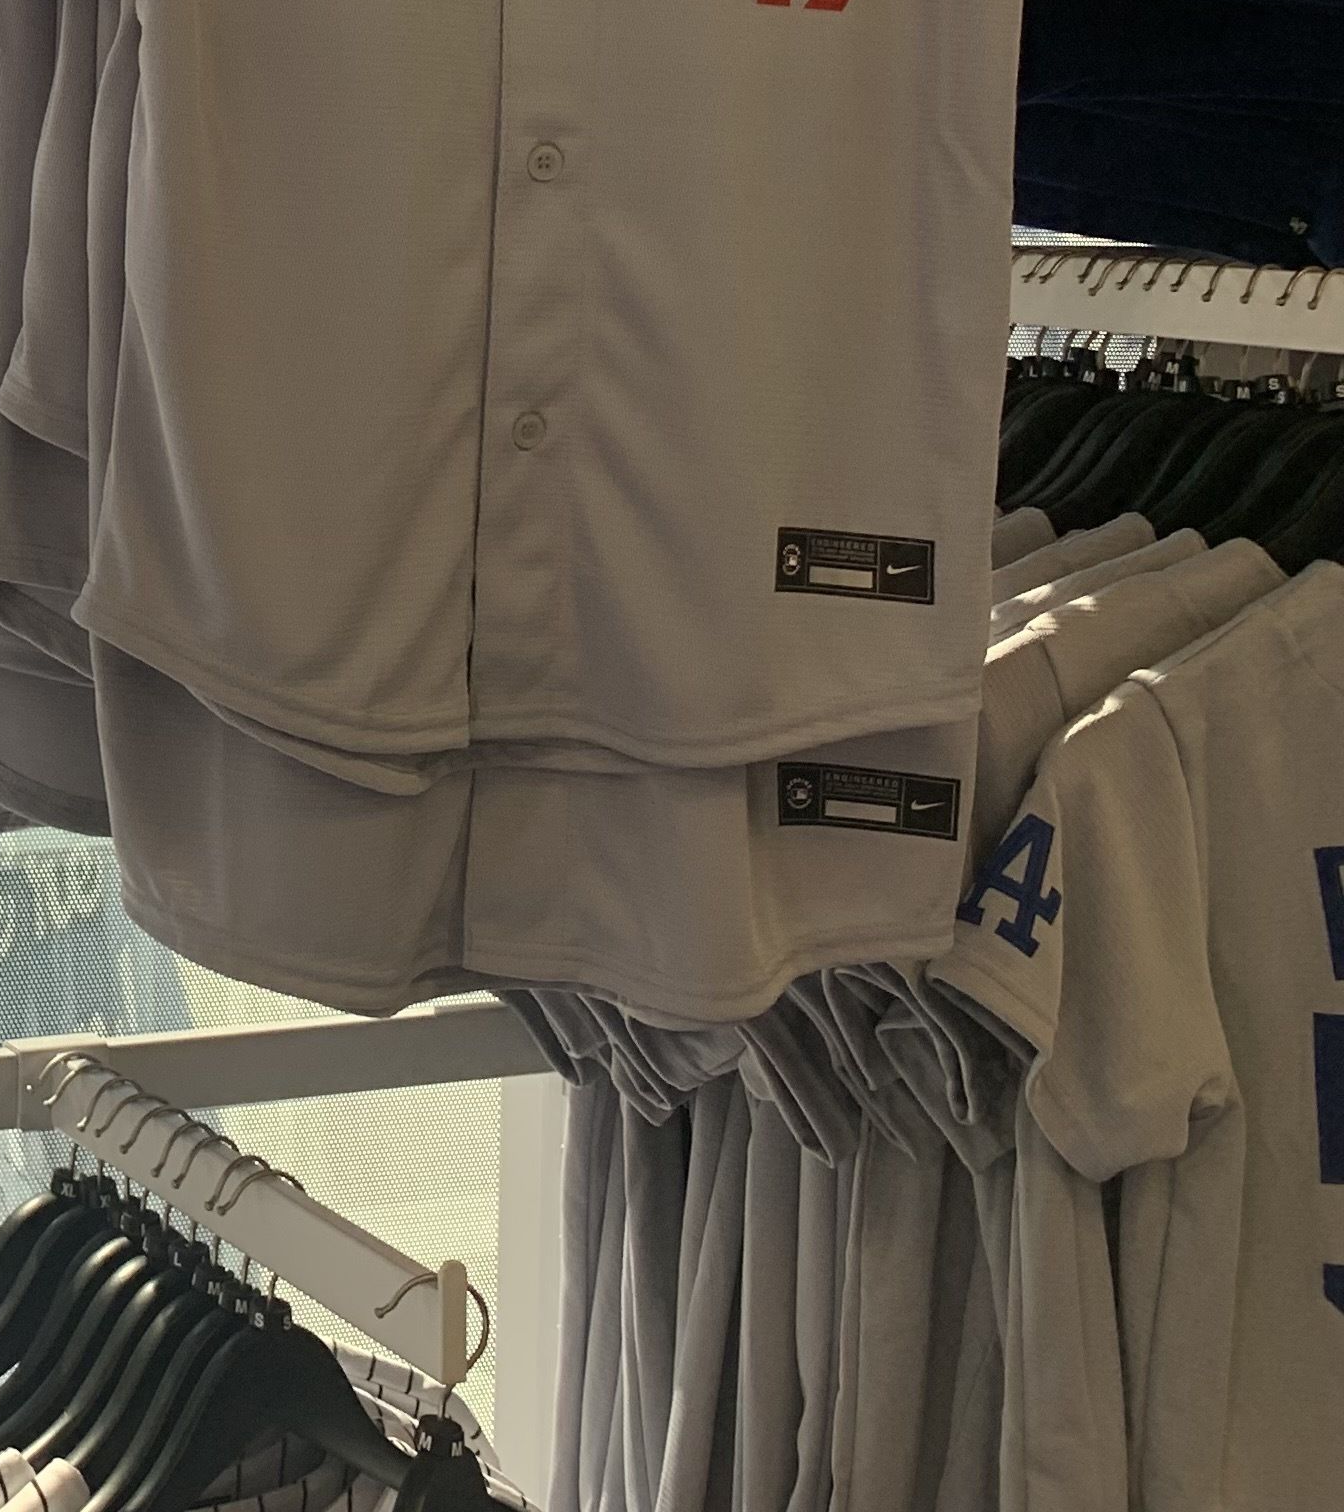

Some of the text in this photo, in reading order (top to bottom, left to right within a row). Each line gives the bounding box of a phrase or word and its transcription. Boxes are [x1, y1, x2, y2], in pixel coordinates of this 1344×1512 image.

[1268, 377, 1280, 390] S
[1236, 386, 1251, 400] M
[61, 1182, 77, 1198] XL
[173, 1251, 183, 1268] L
[235, 1298, 248, 1314] M
[254, 1312, 265, 1328] S
[418, 1433, 432, 1452] M
[451, 1441, 463, 1457] M
